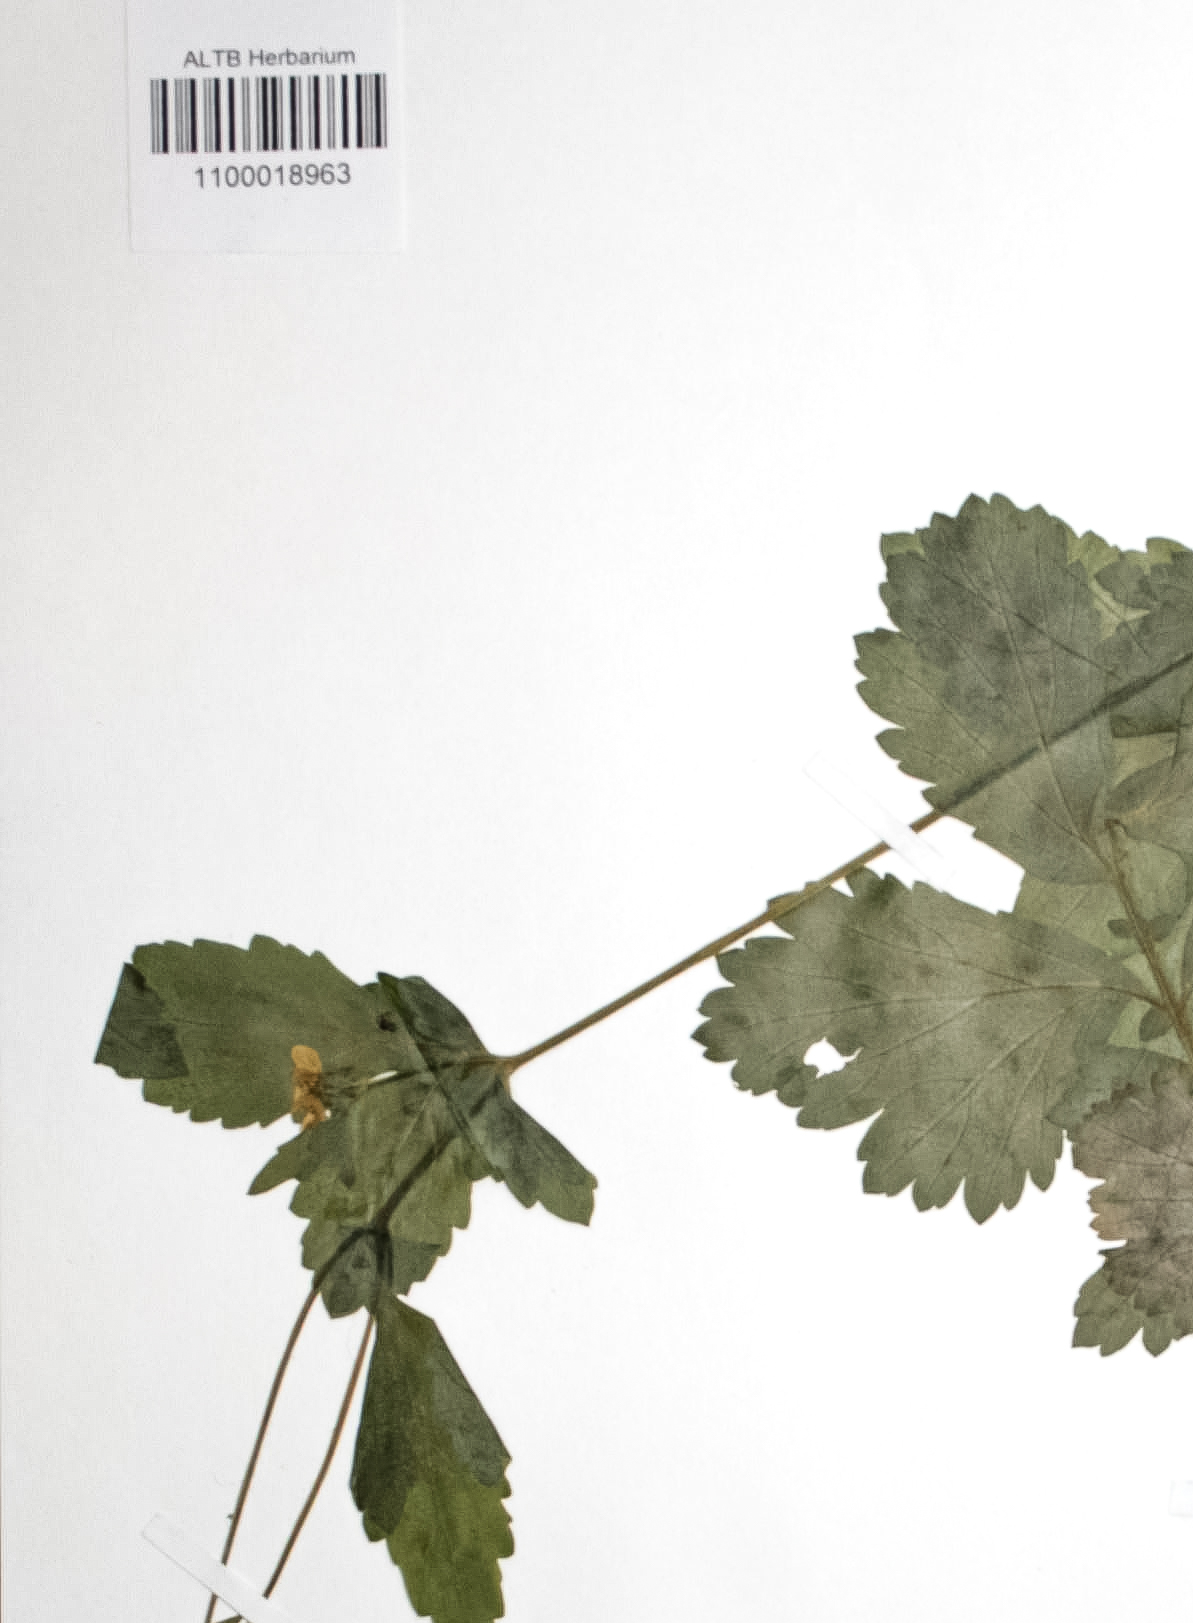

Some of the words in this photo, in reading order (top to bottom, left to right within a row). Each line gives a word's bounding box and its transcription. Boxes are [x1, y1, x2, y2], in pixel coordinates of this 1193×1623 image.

[183, 49, 241, 68] ALTB
[249, 47, 356, 66] Herbarium
[194, 162, 351, 188] 1100018963
